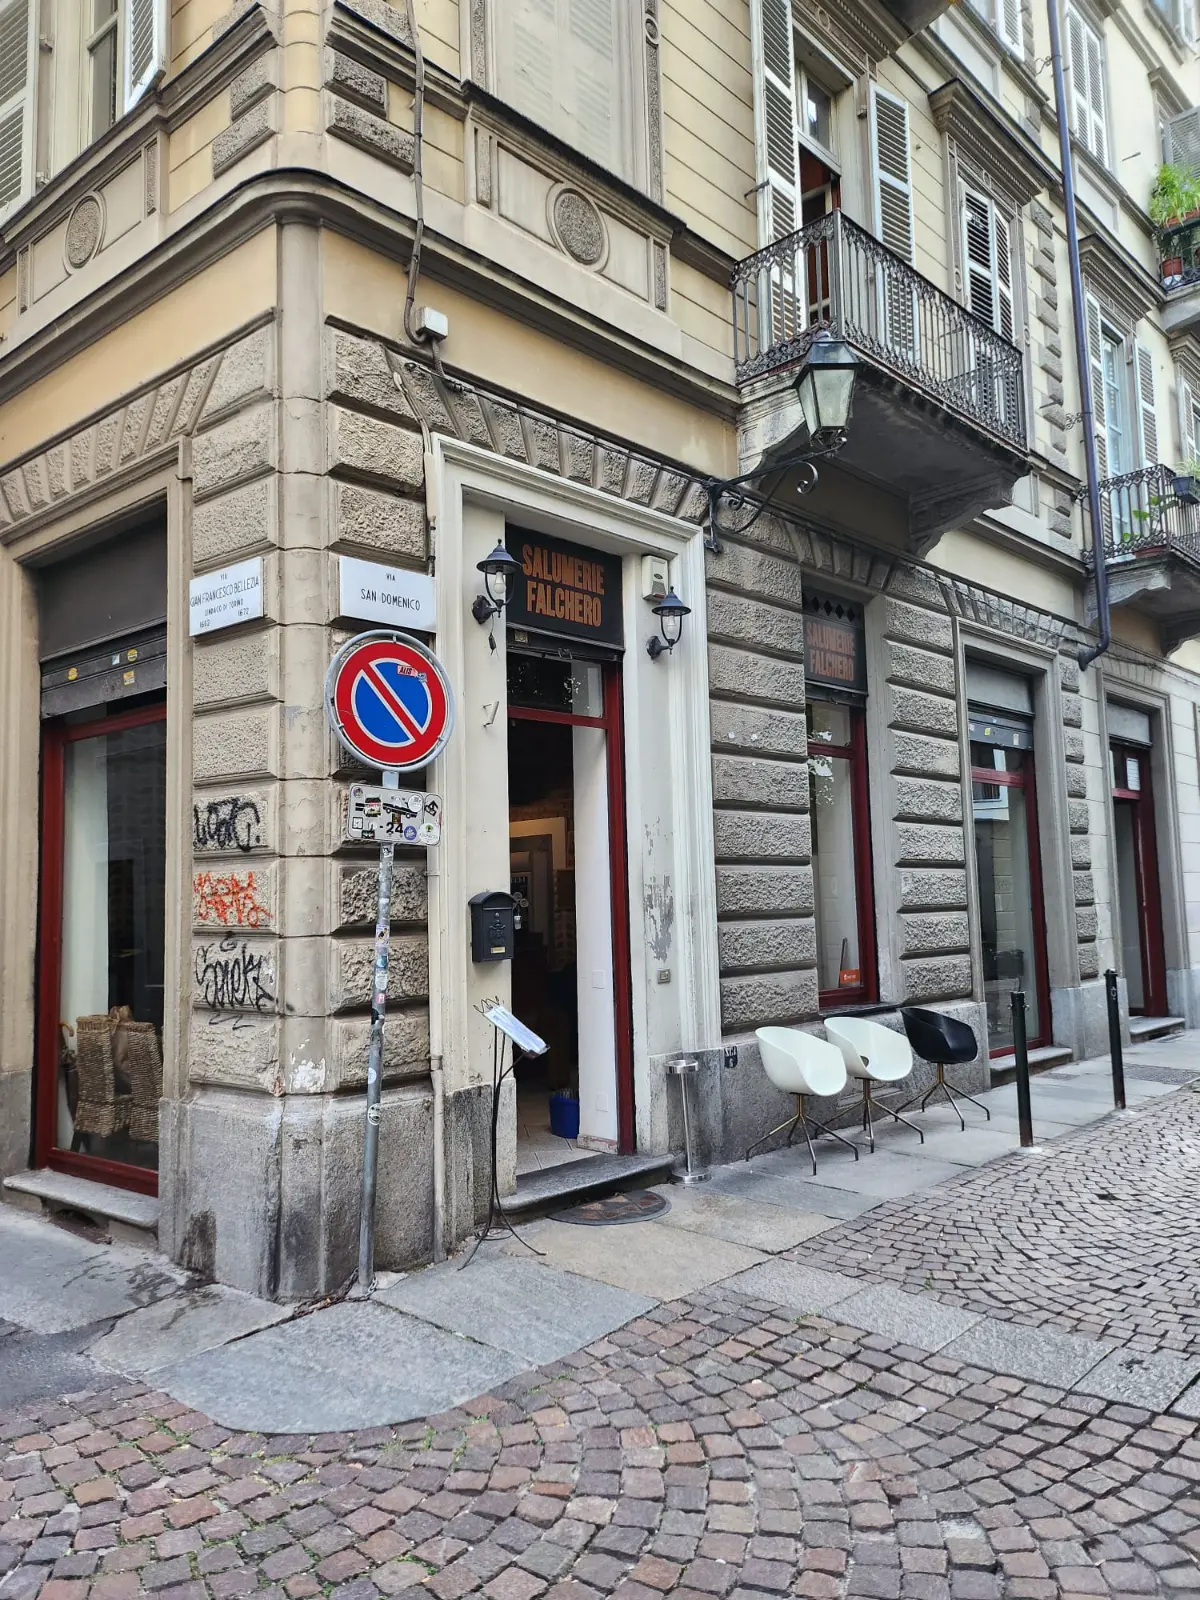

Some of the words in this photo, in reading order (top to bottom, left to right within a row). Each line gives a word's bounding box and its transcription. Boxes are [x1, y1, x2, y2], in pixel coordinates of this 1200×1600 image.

[386, 573, 396, 581] VIA
[522, 544, 604, 595] SALUMERIE
[190, 594, 201, 607] GIAN
[202, 584, 233, 604] FRANCESCO
[234, 576, 259, 594] BELLEZIA
[204, 605, 222, 616] SINDACO
[222, 603, 228, 611] DI
[229, 598, 243, 609] TORINO
[360, 588, 377, 602] SAN
[381, 592, 421, 611] DOMENICO
[527, 580, 601, 627] FALCHERO
[807, 622, 855, 656] SALUMERIE
[810, 649, 854, 681] FALCHERO
[386, 822, 404, 834] 24
